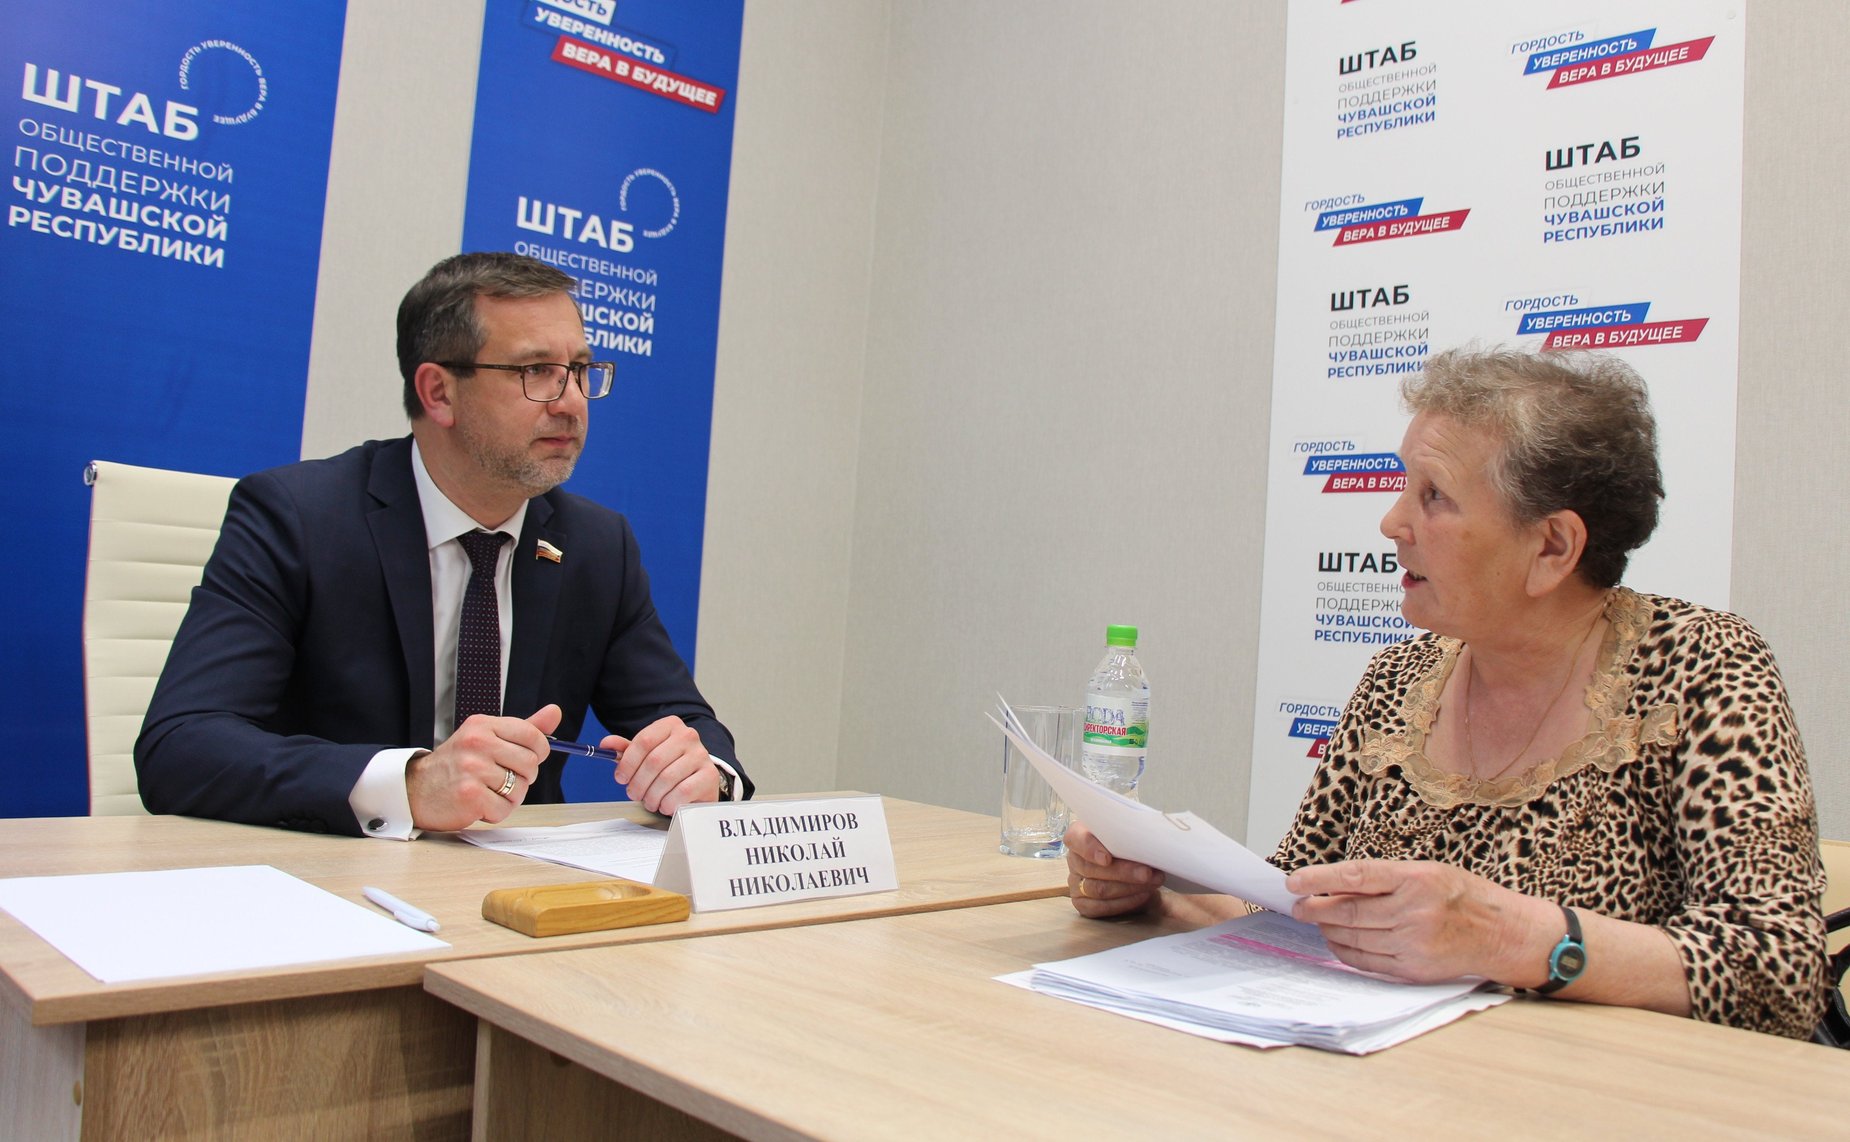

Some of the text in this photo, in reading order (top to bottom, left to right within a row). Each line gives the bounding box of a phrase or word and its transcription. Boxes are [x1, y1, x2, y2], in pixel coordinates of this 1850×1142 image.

[534, 6, 665, 64] УВЕРЕННОСТЬ
[1511, 30, 1584, 54] ГОРДОСТЬ
[1339, 41, 1417, 75] ШТАБ
[1532, 38, 1638, 70] УВЕРЕННОСТЬ
[1559, 46, 1689, 84] ВЕРА В БУДУЩЕЕ
[562, 42, 717, 106] ВЕРА В БУДУЩЕЕ
[1338, 62, 1437, 93] ОБЩЕСТВЕННОЙ
[22, 62, 199, 141] ШТАБ
[1337, 80, 1436, 110] ПОДДЕРЖКИ
[1338, 92, 1436, 124] ЧУВАШСКОЙ
[1337, 110, 1435, 140] РЕСПУБЛИКИ
[19, 118, 234, 184] ОБЩЕСТВЕННОЙ
[1546, 136, 1640, 171] ШТАБ
[14, 145, 231, 214] ПОДДЕРЖКИ
[1544, 162, 1665, 191] ОБЩЕСТВЕННОЙ
[12, 176, 228, 241] ЧУВАШСКОЙ
[1304, 193, 1365, 212] ГОРДОСТЬ
[1544, 181, 1665, 210] ПОДДЕРЖКИ
[516, 196, 634, 253] ШТАБ
[1321, 205, 1408, 228] УВЕРЕННОСТЬ
[1544, 196, 1664, 226] ЧУВАШСКОЙ
[8, 204, 225, 268] РЕСПУБЛИКИ
[1343, 216, 1450, 242] ВЕРА В БУДУЩЕЕ
[1543, 216, 1663, 244] РЕСПУБЛИКИ
[514, 241, 658, 287] ОБЩЕСТВЕННОЙ
[1331, 284, 1409, 312] ШТАБ
[1505, 294, 1578, 311] ГОРДОСТЬ
[582, 302, 654, 335] ШСКОЙ
[1330, 311, 1430, 330] ОБЩЕСТВЕННОЙ
[1526, 310, 1632, 330] УВЕРЕННОСТЬ
[584, 326, 652, 357] БЛИКИ
[1328, 328, 1428, 348] ПОДДЕРЖКИ
[1328, 342, 1428, 362] ЧУВАШСКОЙ
[1552, 326, 1683, 348] ВЕРА В БУДУЩЕЕ
[1294, 441, 1355, 454] ГОРДОСТЬ
[1311, 458, 1398, 472] УВЕРЕННОСТЬ
[1332, 477, 1364, 489] ВЕРА
[1367, 477, 1376, 489] В
[1318, 552, 1398, 573] ШТАБ
[1317, 582, 1406, 593] ОБЩЕСТВЕНН
[1280, 702, 1340, 717] ГОРДОСТЬ
[718, 812, 859, 839] ВЛАДИМИРОВ
[745, 836, 846, 866] НИКОЛАЙ
[729, 866, 870, 898] НИКОЛАЕВИЧ
